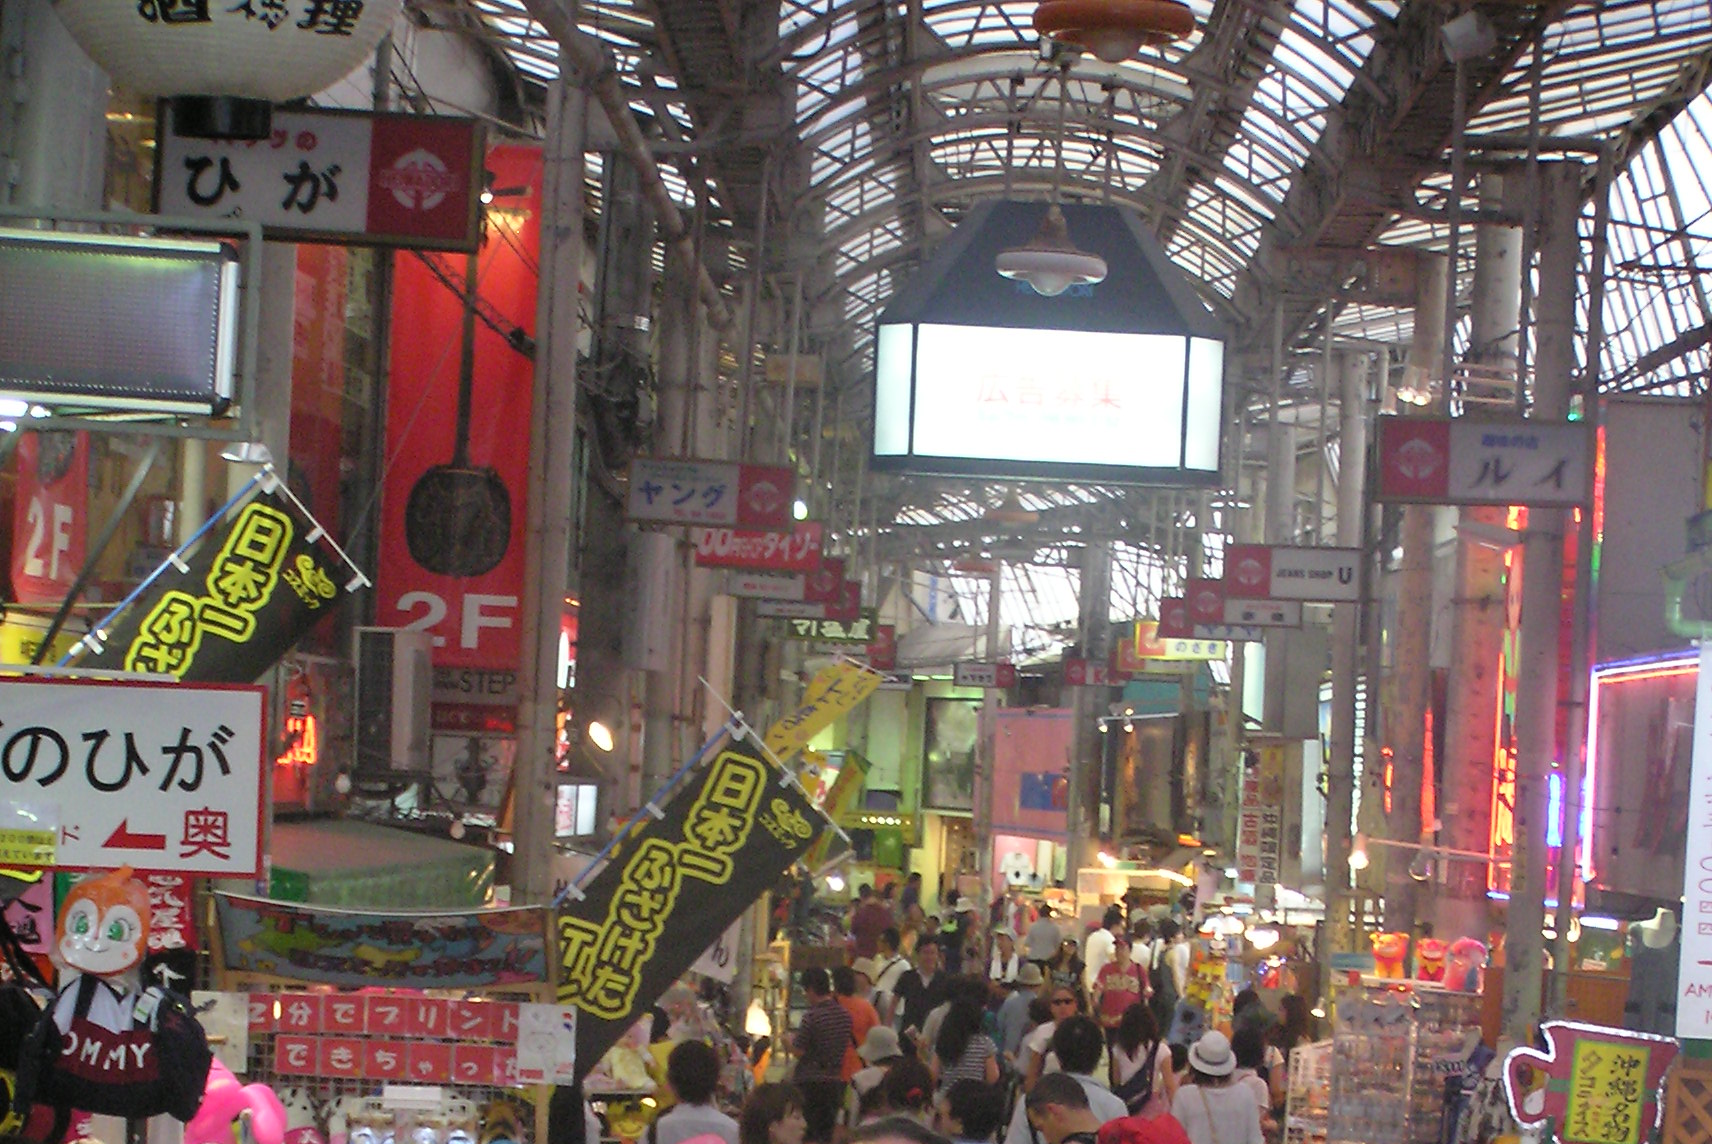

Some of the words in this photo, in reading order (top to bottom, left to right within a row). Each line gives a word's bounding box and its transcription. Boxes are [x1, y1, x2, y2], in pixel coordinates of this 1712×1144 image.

[184, 156, 342, 214] ひが
[638, 480, 728, 509] ヤング
[24, 496, 73, 580] 2F
[199, 507, 286, 637] 日本一
[0, 723, 236, 793] のひが
[179, 806, 232, 861] 奥
[679, 758, 758, 879] 日本一
